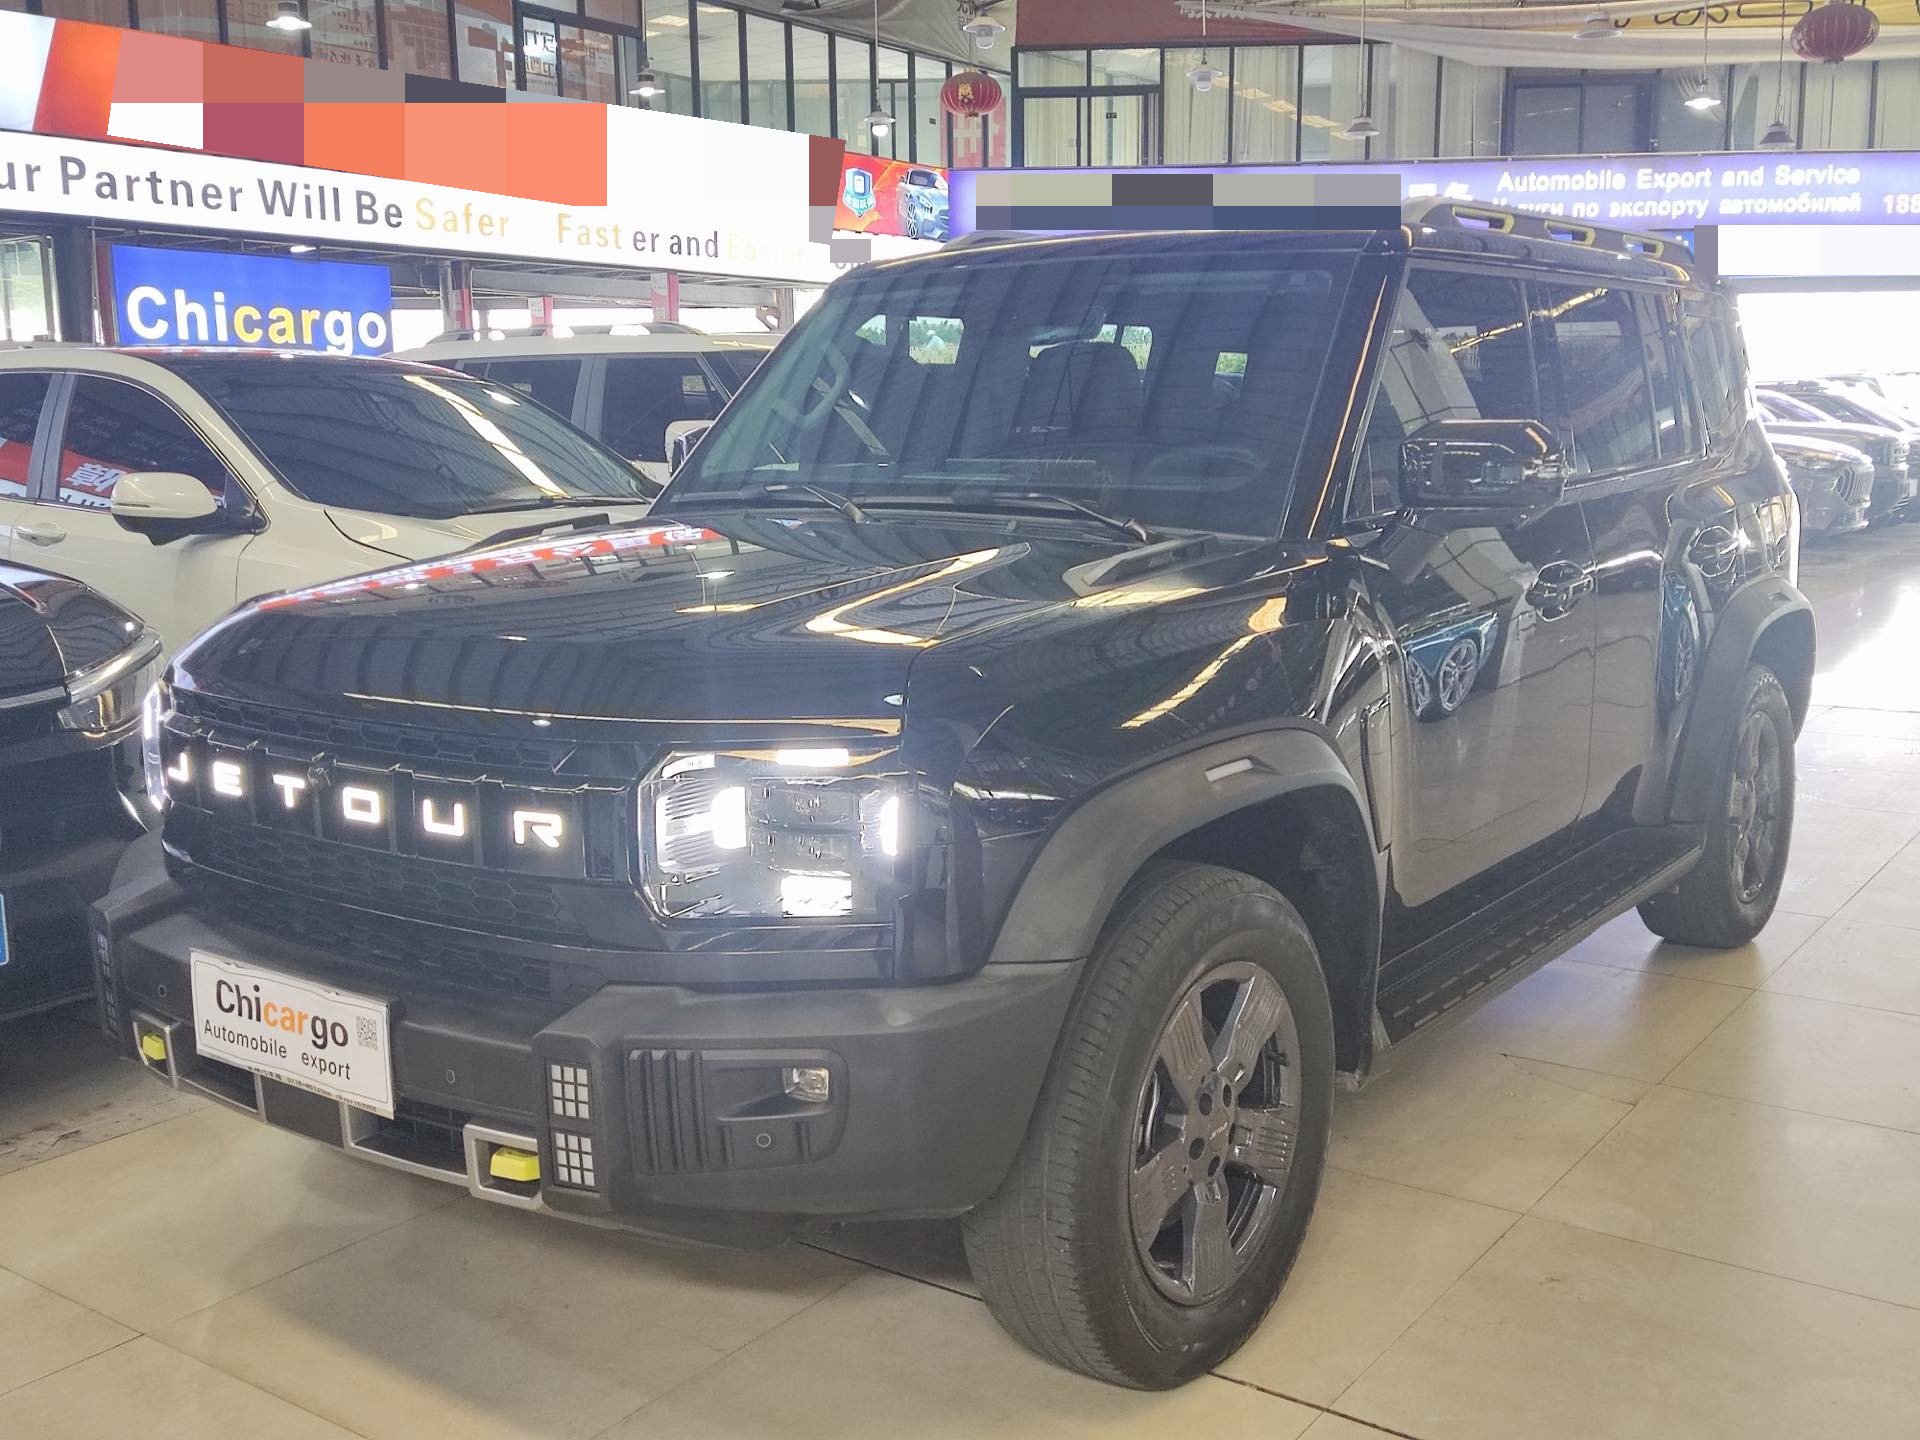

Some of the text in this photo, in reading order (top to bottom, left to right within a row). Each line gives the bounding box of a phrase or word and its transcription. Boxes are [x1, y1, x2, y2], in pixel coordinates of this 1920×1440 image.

[60, 156, 243, 212] Partner
[258, 178, 341, 222] Will
[356, 190, 403, 228] Be
[415, 197, 510, 238] Safer
[669, 231, 718, 258] and
[1498, 169, 1626, 193] Automobile
[1637, 167, 1712, 192] Export
[1721, 166, 1764, 187] and
[1775, 164, 1860, 186] Service
[1572, 201, 1598, 217] по
[1609, 198, 1710, 219] экспорту
[127, 287, 387, 355] Chicargo
[168, 752, 563, 848] JETOUR
[216, 979, 348, 1049] Chicargo
[204, 1019, 350, 1080] Automobile export
